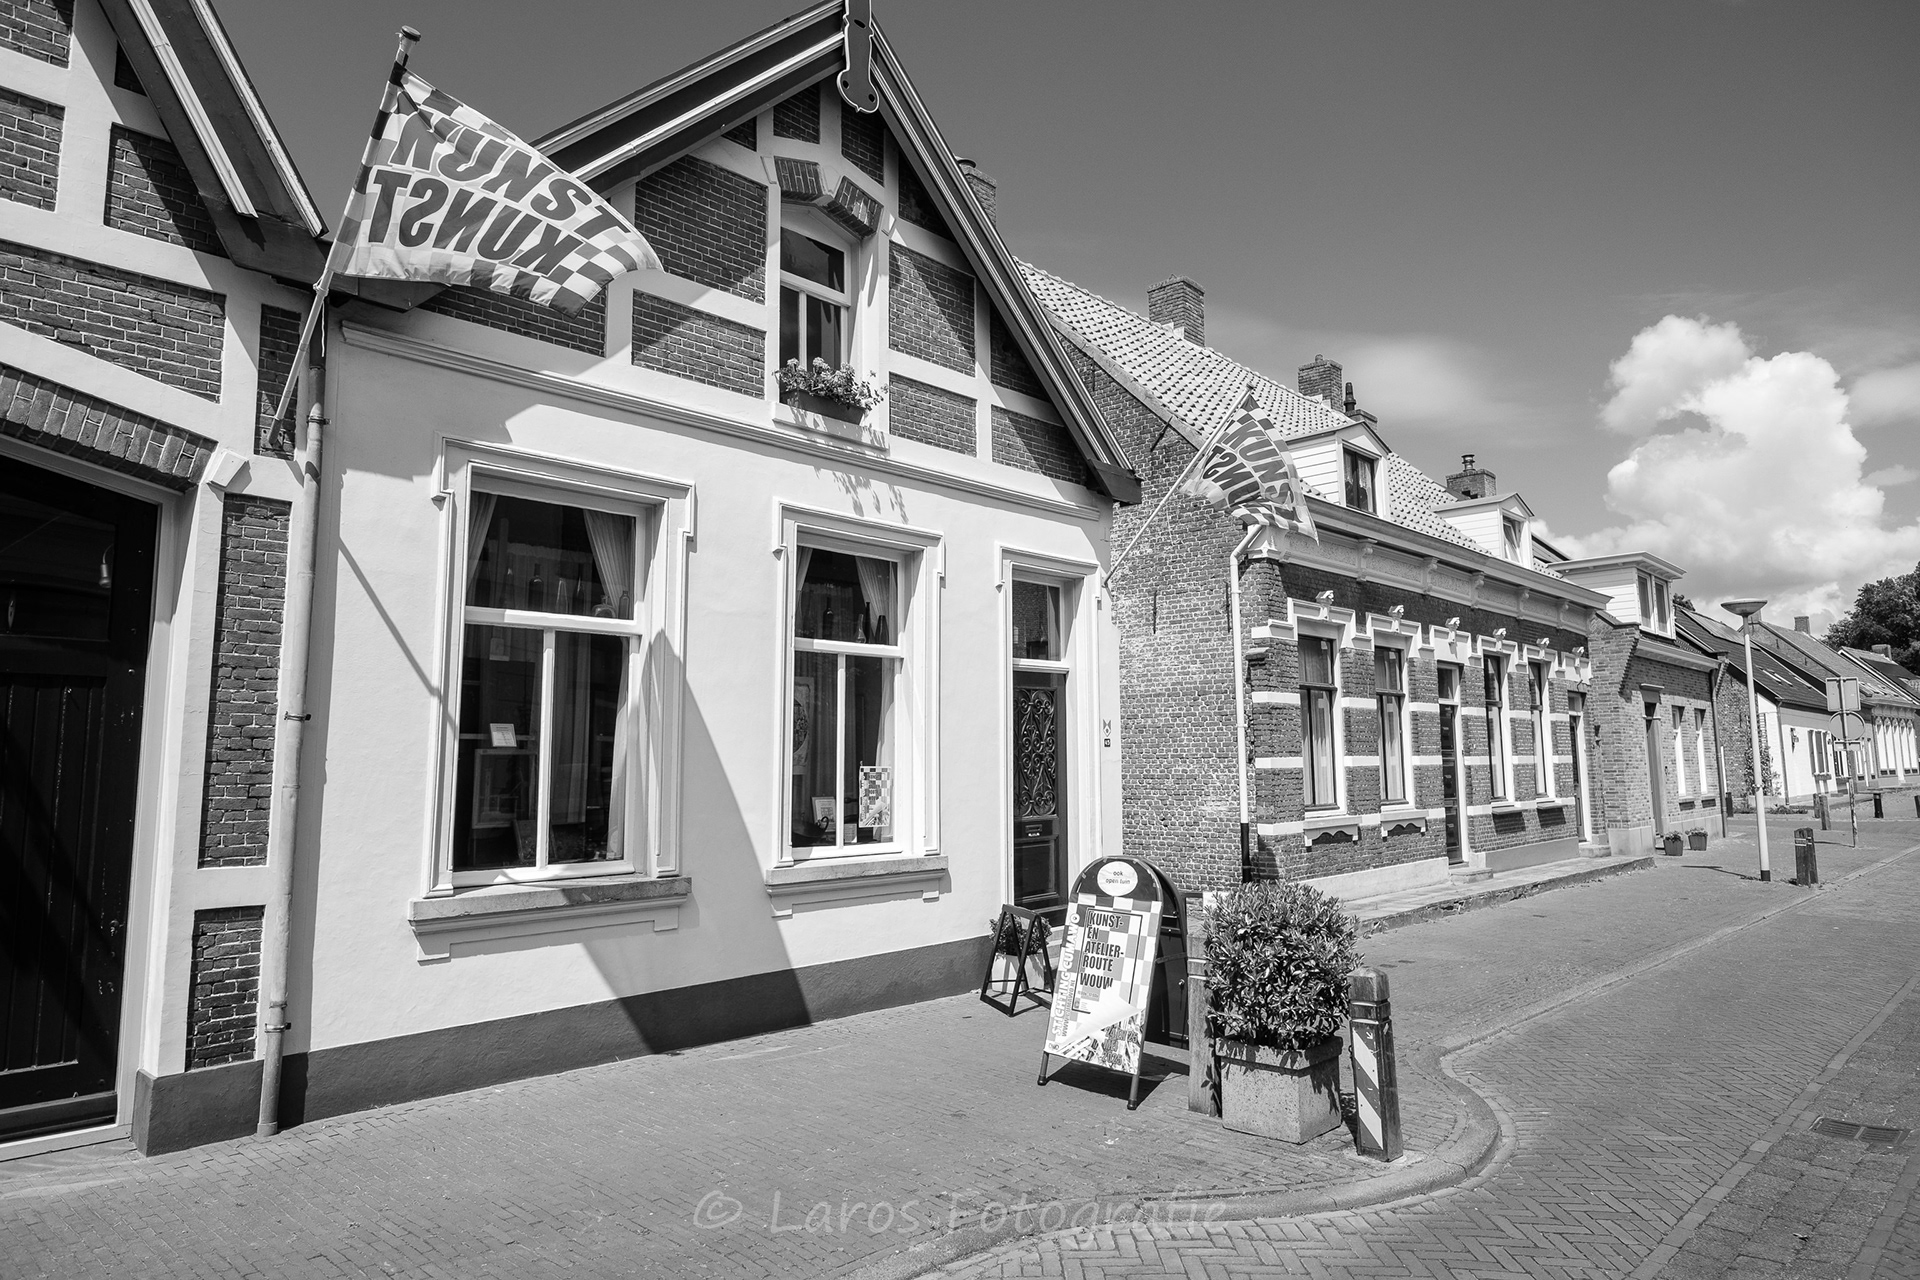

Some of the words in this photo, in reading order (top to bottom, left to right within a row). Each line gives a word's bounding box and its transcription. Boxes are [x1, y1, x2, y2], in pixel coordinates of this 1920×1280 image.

[1088, 911, 1123, 928] KUNST-
[1087, 927, 1099, 940] EN
[1084, 941, 1124, 958] ATELIER-
[1082, 955, 1114, 972] ROUTE
[1052, 971, 1071, 1036] STICHTING
[1062, 913, 1080, 971] CUMAWO
[1079, 972, 1114, 990] WOUW
